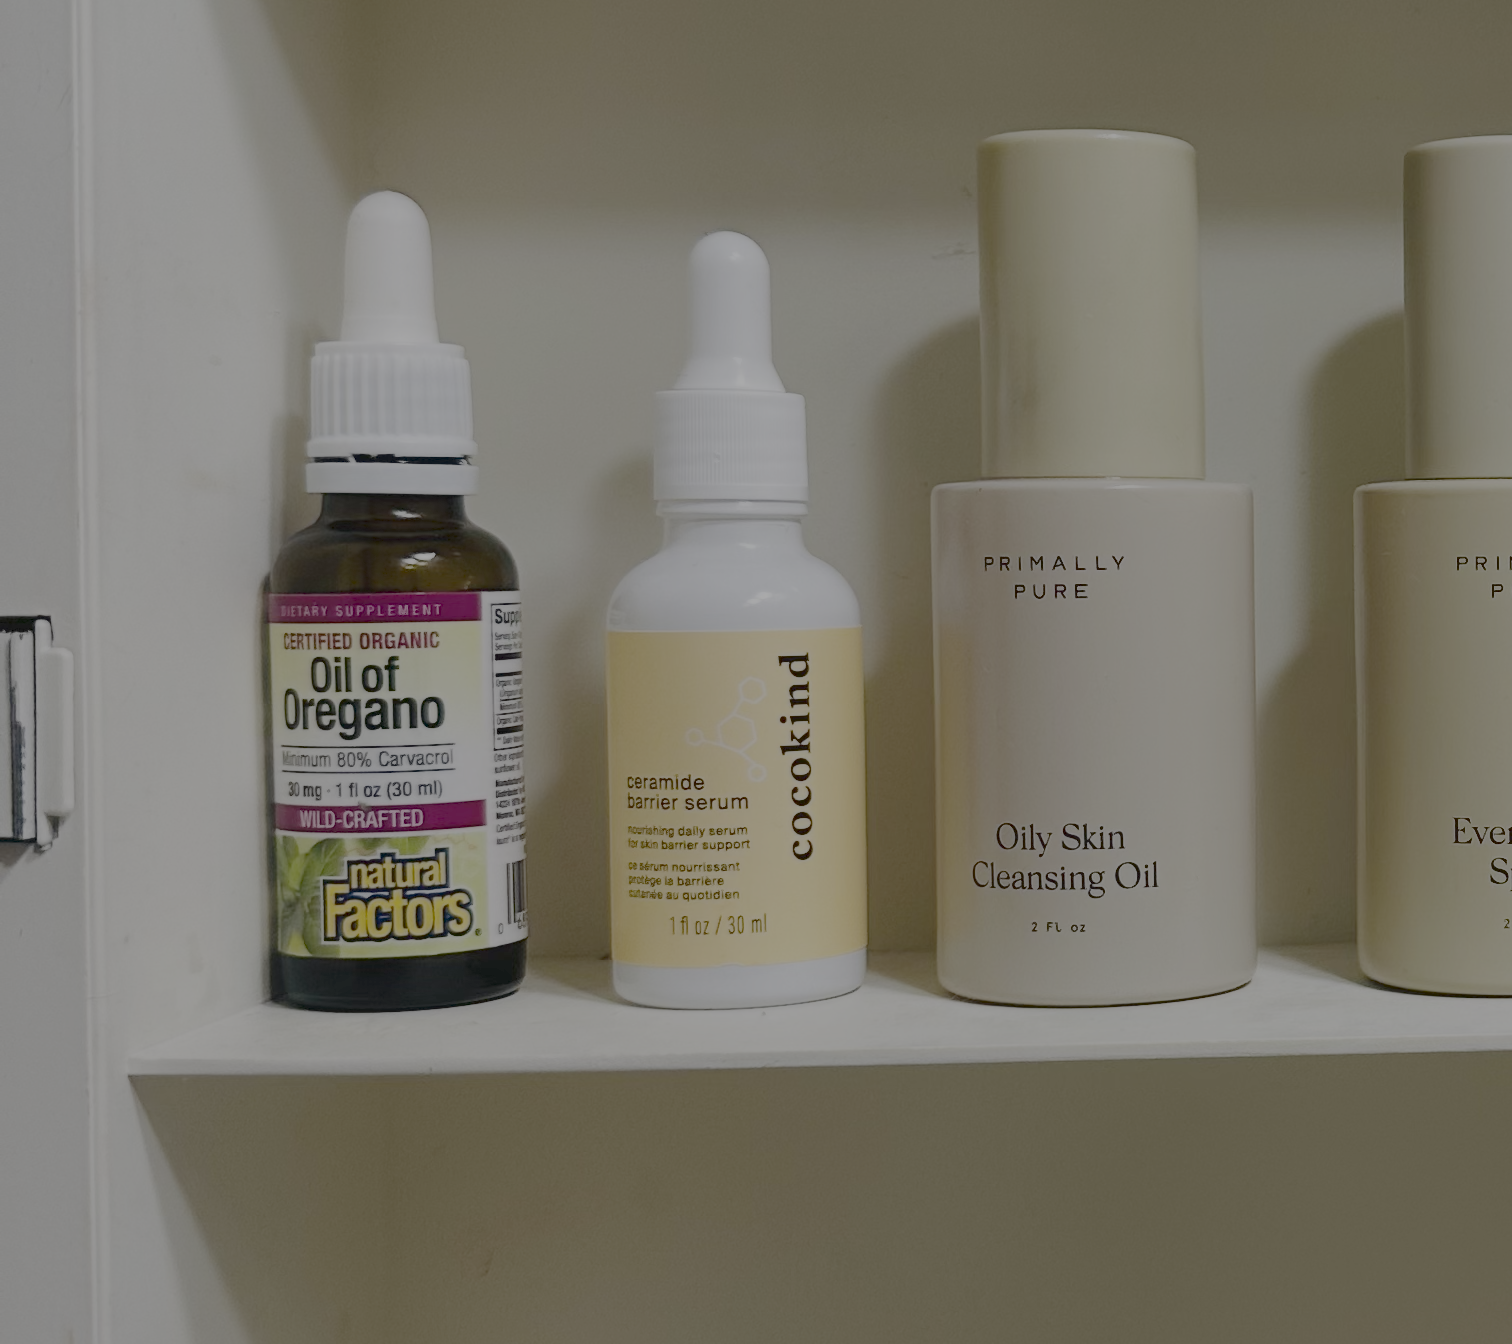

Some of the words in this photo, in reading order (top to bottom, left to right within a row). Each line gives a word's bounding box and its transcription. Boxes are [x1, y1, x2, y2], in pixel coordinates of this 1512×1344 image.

[984, 555, 1124, 572] PRIMALLY
[1014, 583, 1089, 599] PURE
[281, 603, 328, 617] DIETARY
[335, 603, 442, 617] SUPPLEMENT
[283, 632, 352, 650] CERTIFIED
[359, 631, 440, 650] ORGANIC
[310, 656, 352, 693] Oil
[361, 656, 400, 692] of
[284, 688, 446, 740] Oregano
[282, 750, 331, 767] Minimum
[337, 751, 372, 767] 80%
[378, 748, 453, 767] Carvacrol
[778, 652, 813, 861] cocokind
[303, 785, 322, 801] mg
[336, 782, 342, 797] 1
[349, 782, 358, 797] fl
[363, 785, 381, 798] oz
[387, 781, 413, 800] (30
[418, 779, 442, 799] ml)
[627, 774, 705, 791] ceramide
[627, 792, 679, 810] barrier
[685, 796, 749, 810] serum
[300, 808, 424, 829] WILD-CRAFTED
[628, 825, 675, 838] nourishing
[677, 826, 706, 838] daily
[708, 826, 748, 837] serum
[996, 822, 1053, 857] Oily
[1061, 822, 1126, 851] Skin
[628, 837, 638, 848] for
[640, 838, 659, 849] skin
[661, 839, 699, 850] barrier
[702, 839, 750, 851] support
[348, 849, 448, 890] natural
[671, 861, 740, 872] nourrissant
[664, 875, 674, 886] la
[677, 876, 724, 886] barrière
[972, 860, 1106, 899] Cleansing
[1114, 860, 1159, 889] Oil
[666, 891, 679, 900] au
[682, 889, 740, 902] quotidien
[323, 881, 473, 941] Factors
[670, 916, 675, 935] 1
[680, 915, 689, 935] fl
[695, 920, 710, 935] oz
[715, 914, 722, 935] /
[727, 914, 744, 935] 30
[751, 912, 767, 934] ml
[1031, 921, 1038, 933] 2
[1046, 921, 1062, 933] Fl
[1070, 923, 1086, 933] oz
[1503, 918, 1510, 929] 2
